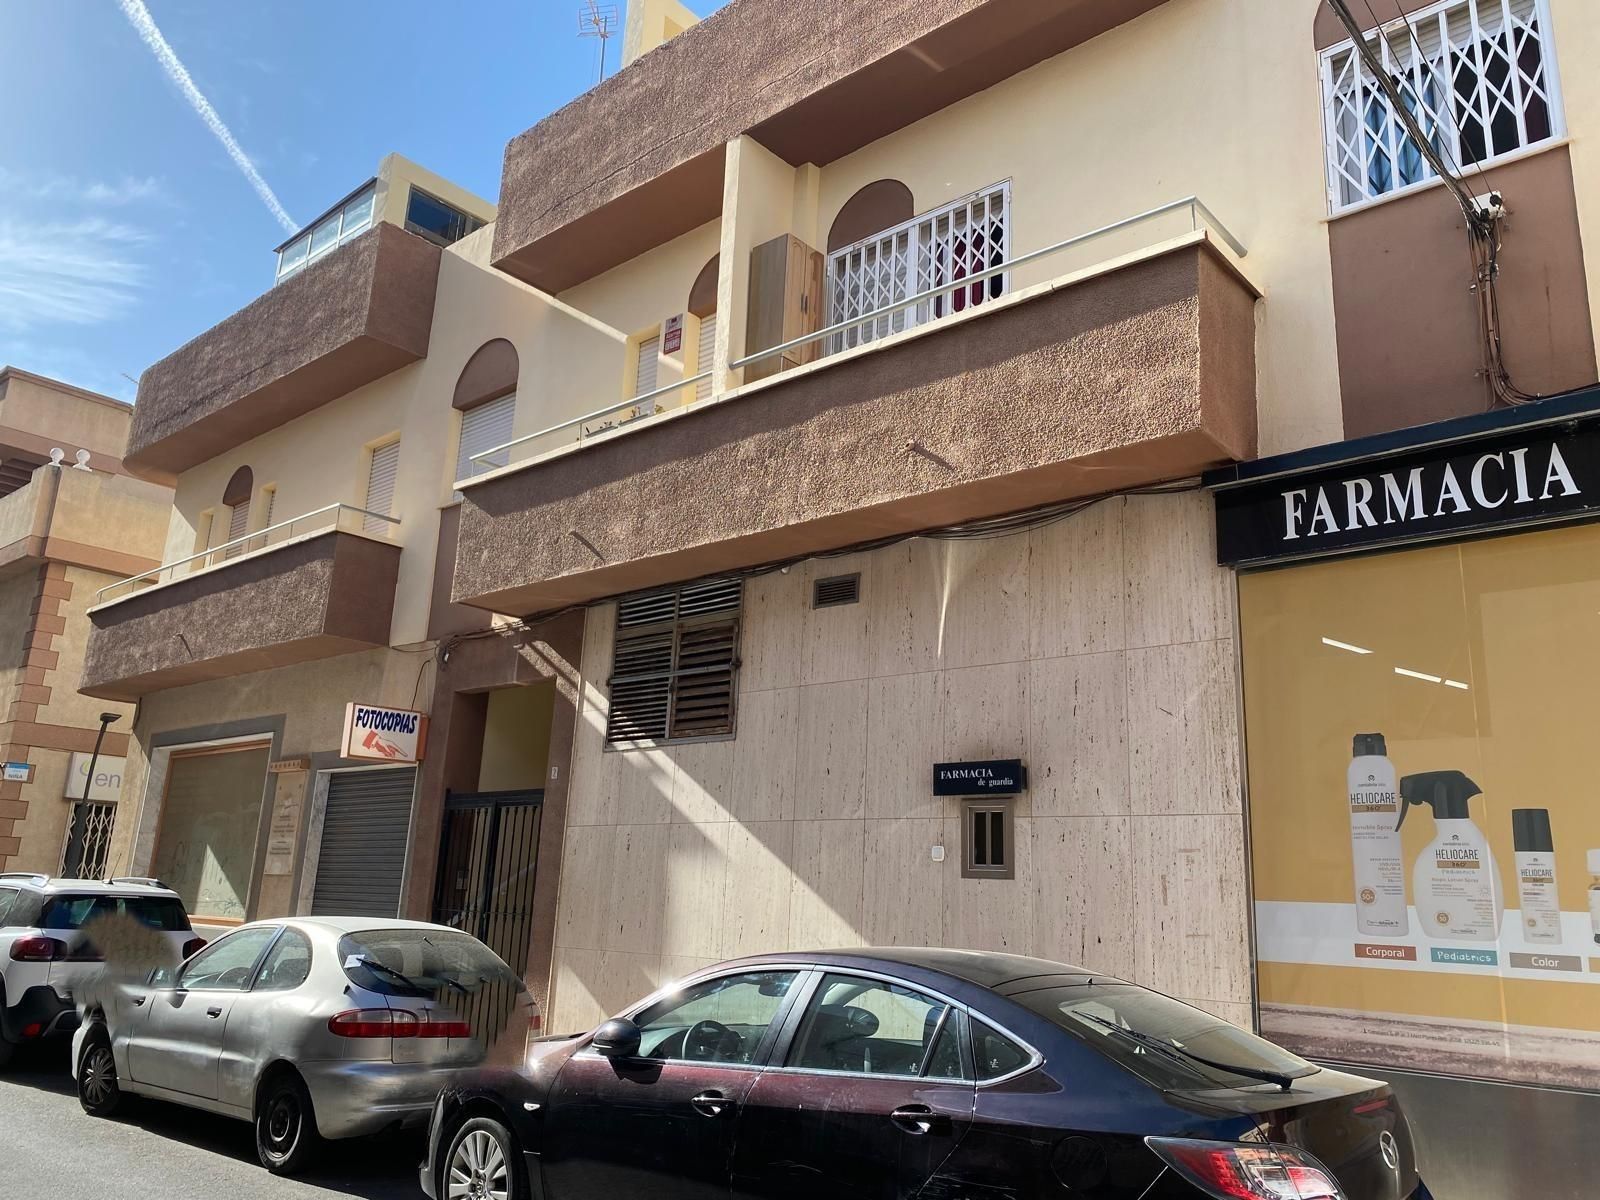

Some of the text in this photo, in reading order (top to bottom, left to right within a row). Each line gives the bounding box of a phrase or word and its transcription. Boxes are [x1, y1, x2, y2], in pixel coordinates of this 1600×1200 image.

[1281, 442, 1581, 540] FARMACIA
[355, 708, 418, 734] FOTOCOPIAS
[940, 768, 993, 780] FARMACIA
[977, 777, 1014, 788] de guardia
[1350, 792, 1396, 805] HELIOCARE
[1435, 849, 1479, 860] HELIOCARE
[1520, 868, 1553, 877] HELIOCARE
[1366, 946, 1405, 957] Corporal
[1437, 951, 1492, 962] Pediatrics
[1531, 956, 1560, 967] Color
